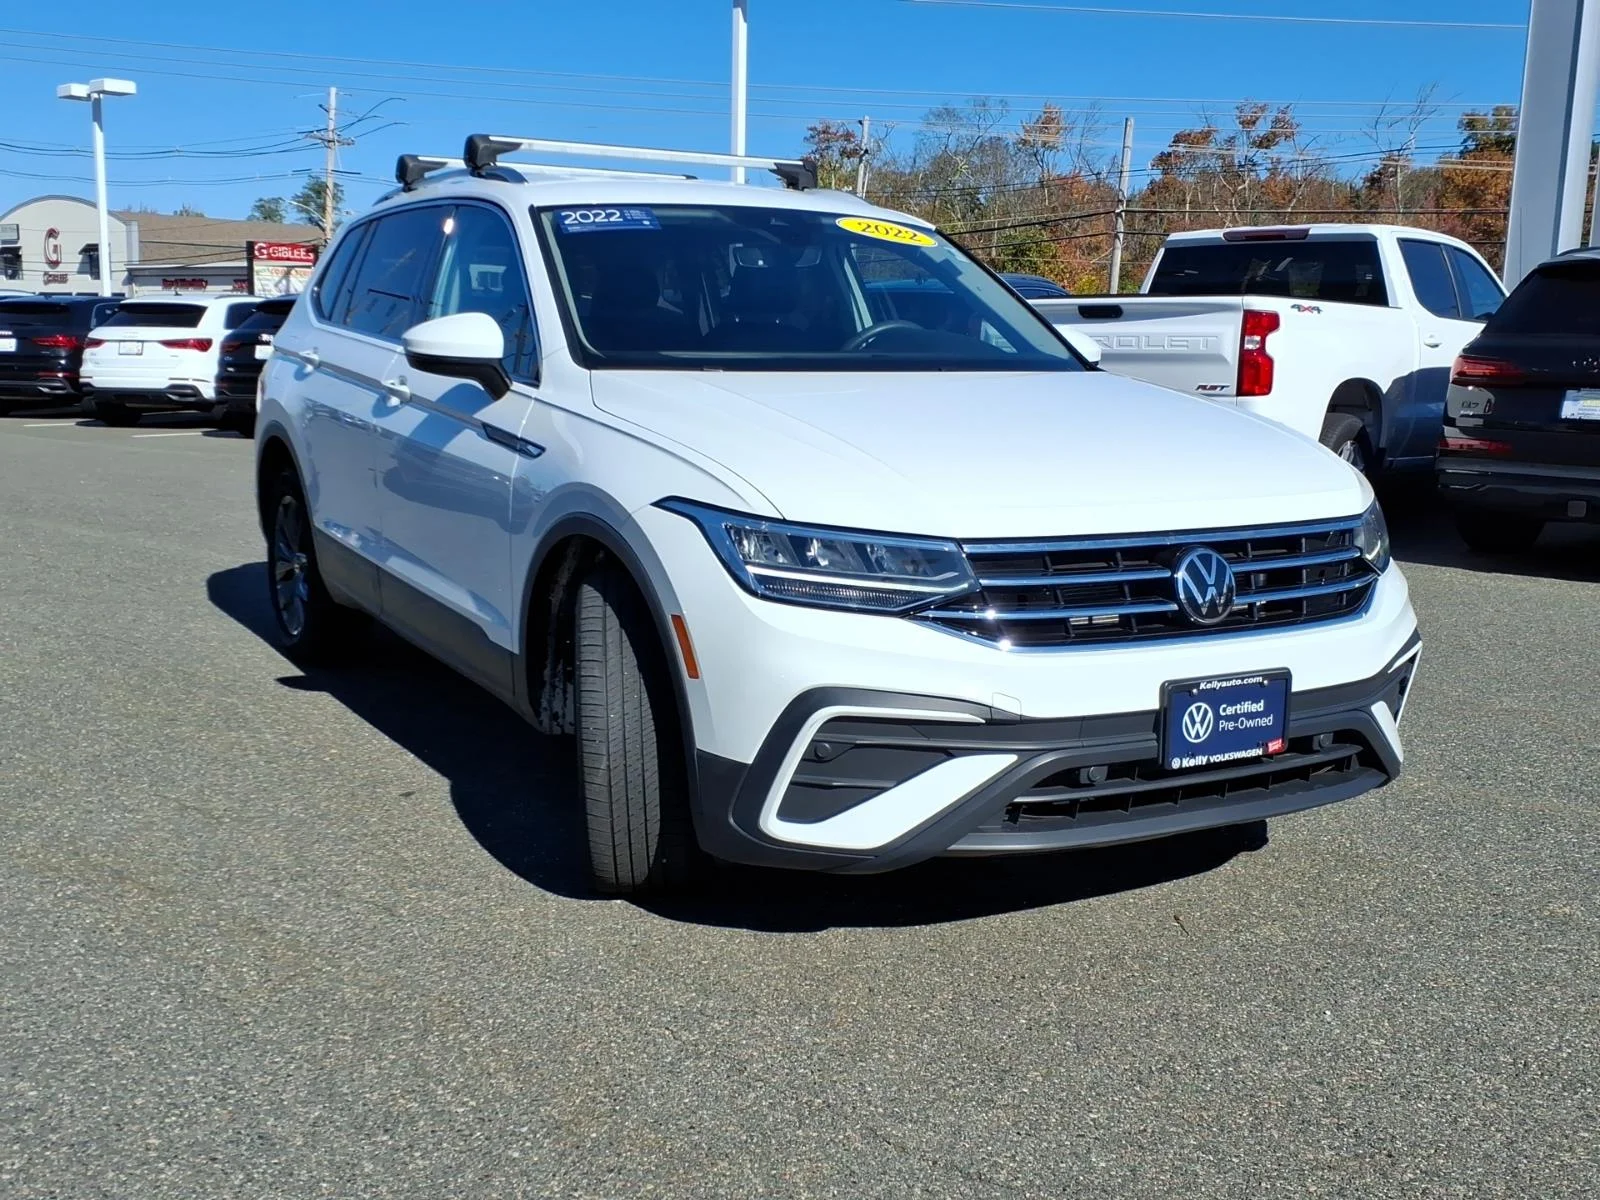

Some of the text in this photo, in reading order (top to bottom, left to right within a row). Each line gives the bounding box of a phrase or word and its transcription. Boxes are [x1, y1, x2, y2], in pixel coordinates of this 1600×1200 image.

[561, 209, 624, 225] 2022
[857, 221, 922, 243] 2022
[1199, 676, 1263, 690] Kellyauto.com
[1219, 699, 1265, 716] Certified
[1218, 714, 1274, 732] Pre-Owned
[1181, 755, 1209, 768] Kelly
[1209, 747, 1264, 763] VOLKSWAGEN
